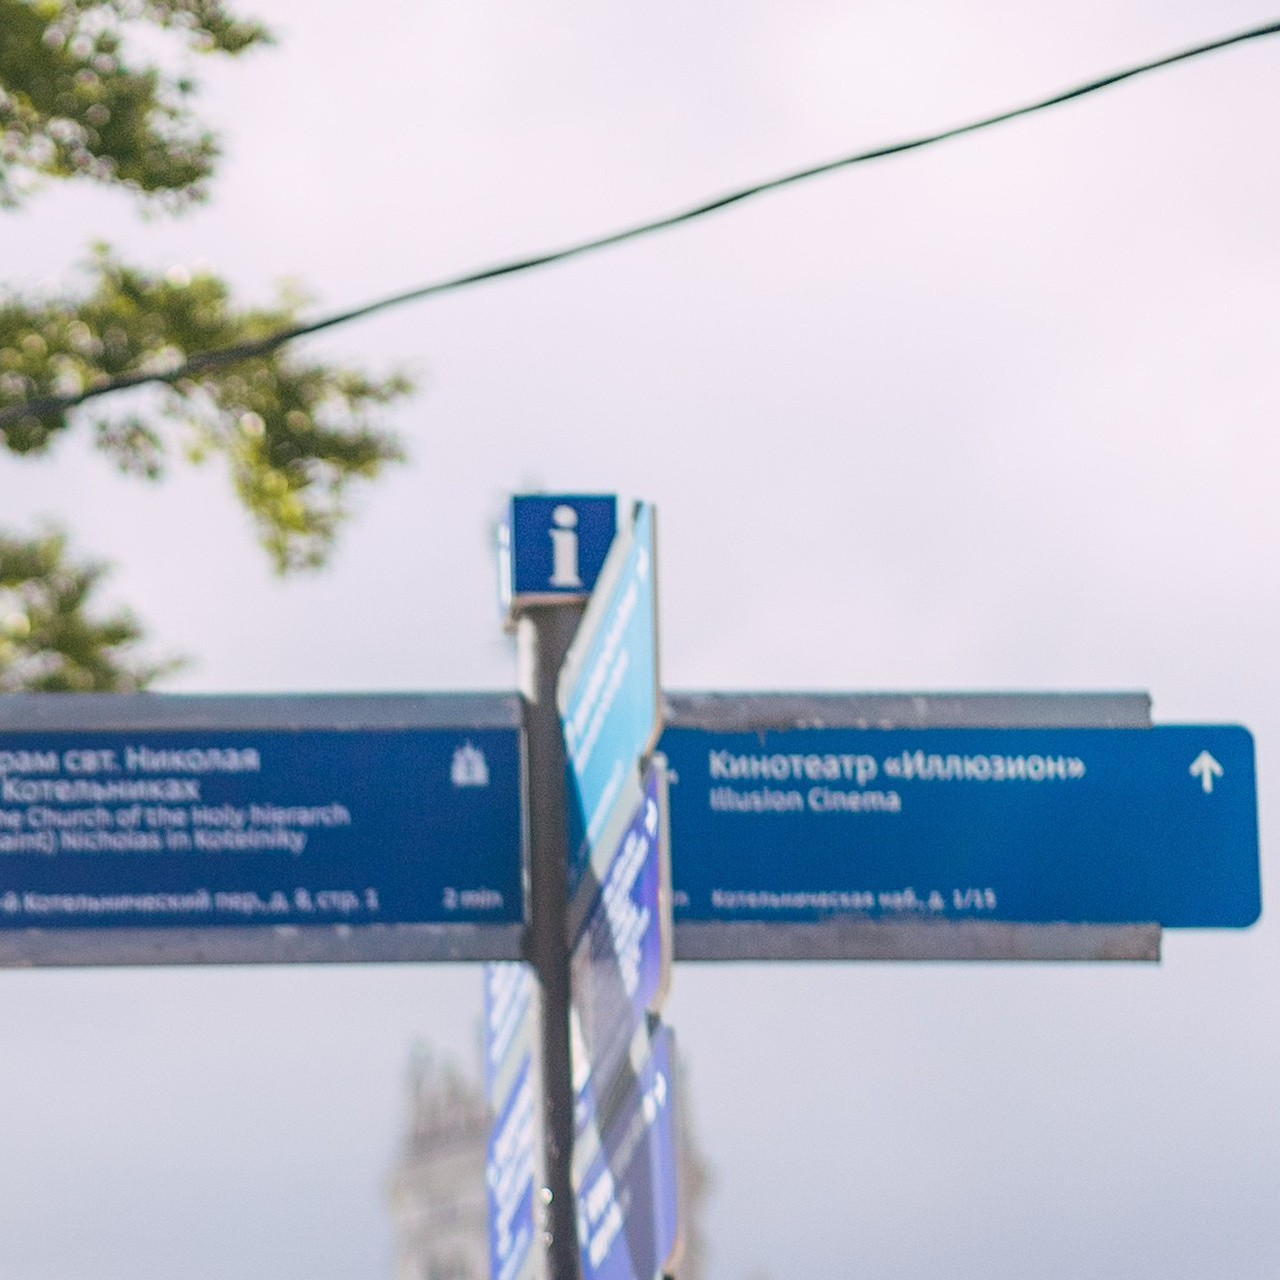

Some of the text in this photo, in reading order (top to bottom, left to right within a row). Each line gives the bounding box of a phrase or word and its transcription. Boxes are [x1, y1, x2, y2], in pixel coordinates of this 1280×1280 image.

[64, 749, 119, 772] свт.
[125, 746, 260, 772] Николая
[709, 749, 1086, 786] Кинотеатр «Иллюзион»
[1, 779, 200, 801] Котельниках
[710, 786, 901, 812] Illusion Cinema
[26, 804, 113, 827] Church
[116, 804, 141, 827] of
[146, 805, 187, 827] the
[192, 803, 245, 830] Holy
[250, 802, 351, 827] hierarch
[60, 829, 161, 850] Nicholas
[166, 829, 190, 850] in
[23, 888, 210, 912] Котельнический
[443, 886, 503, 910] 2 min
[712, 889, 874, 909] Котельническая
